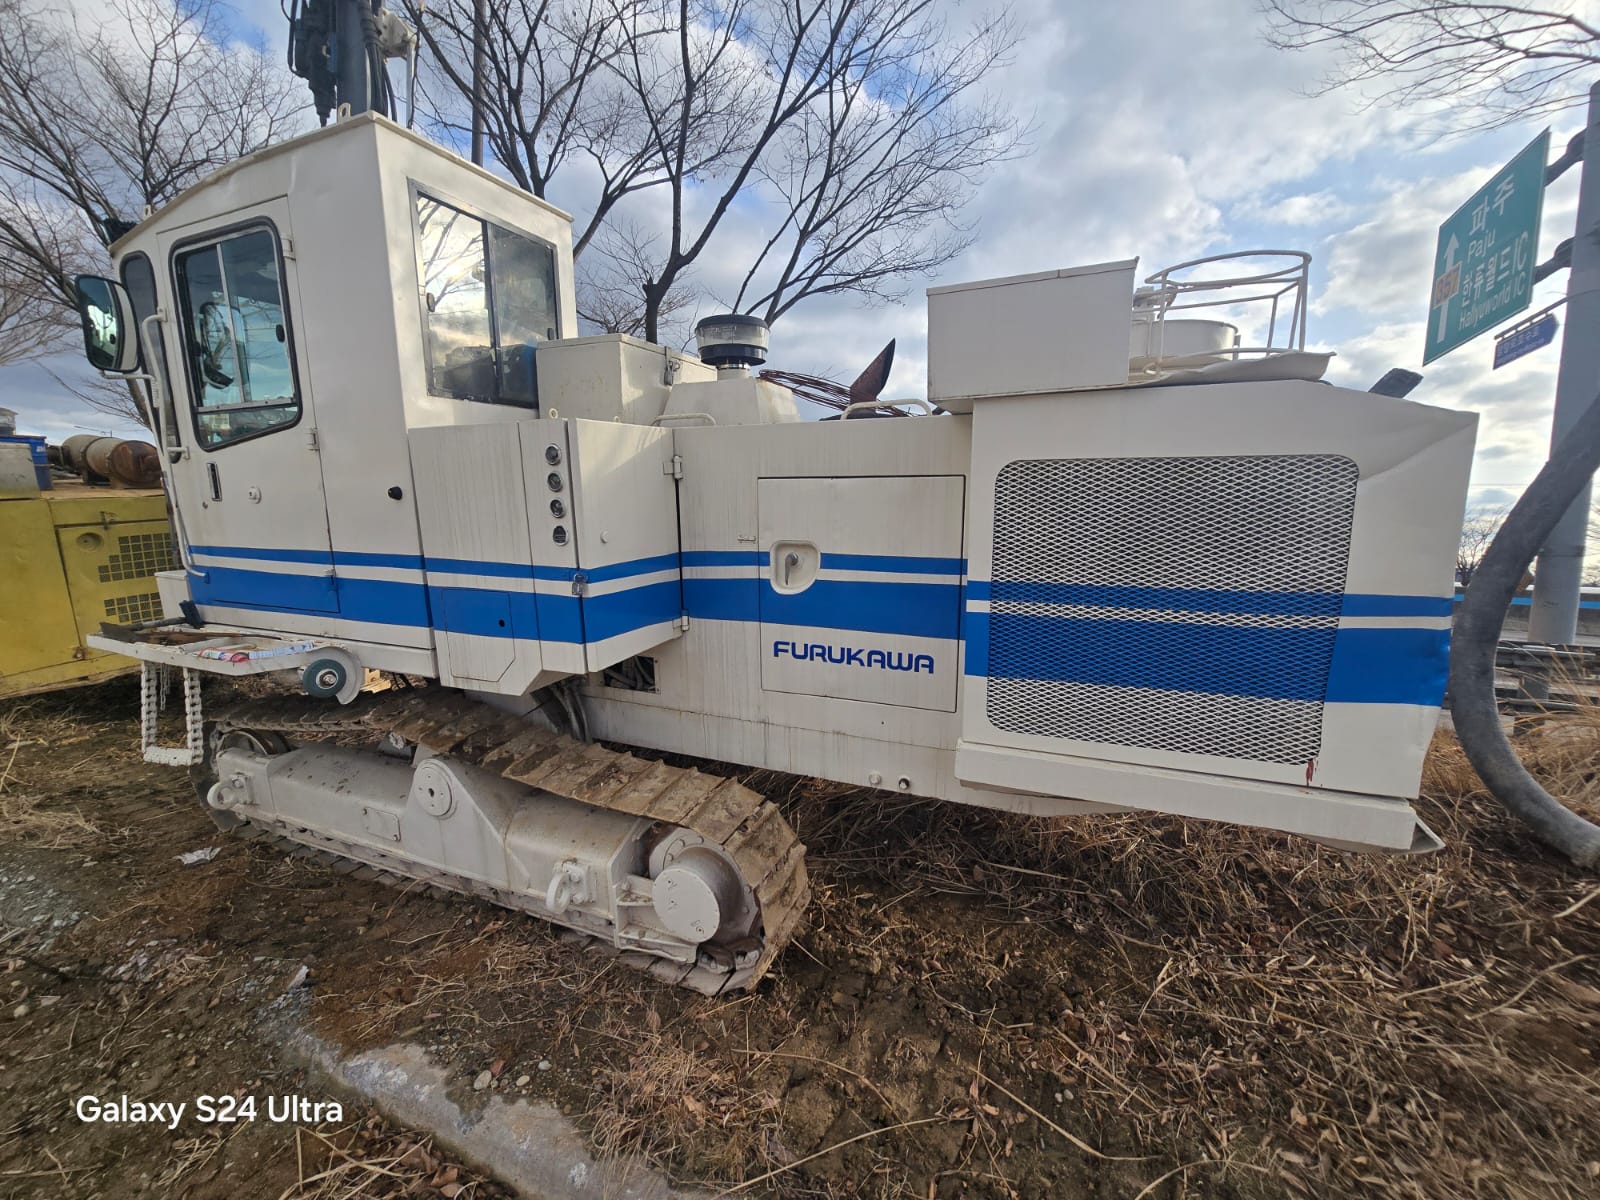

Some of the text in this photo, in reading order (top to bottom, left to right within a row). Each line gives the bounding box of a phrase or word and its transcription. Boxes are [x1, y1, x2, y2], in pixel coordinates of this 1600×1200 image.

[1468, 174, 1514, 236] 파주
[1467, 228, 1496, 263] Paju
[1512, 271, 1526, 299] IC
[773, 640, 935, 674] FURUKAWA
